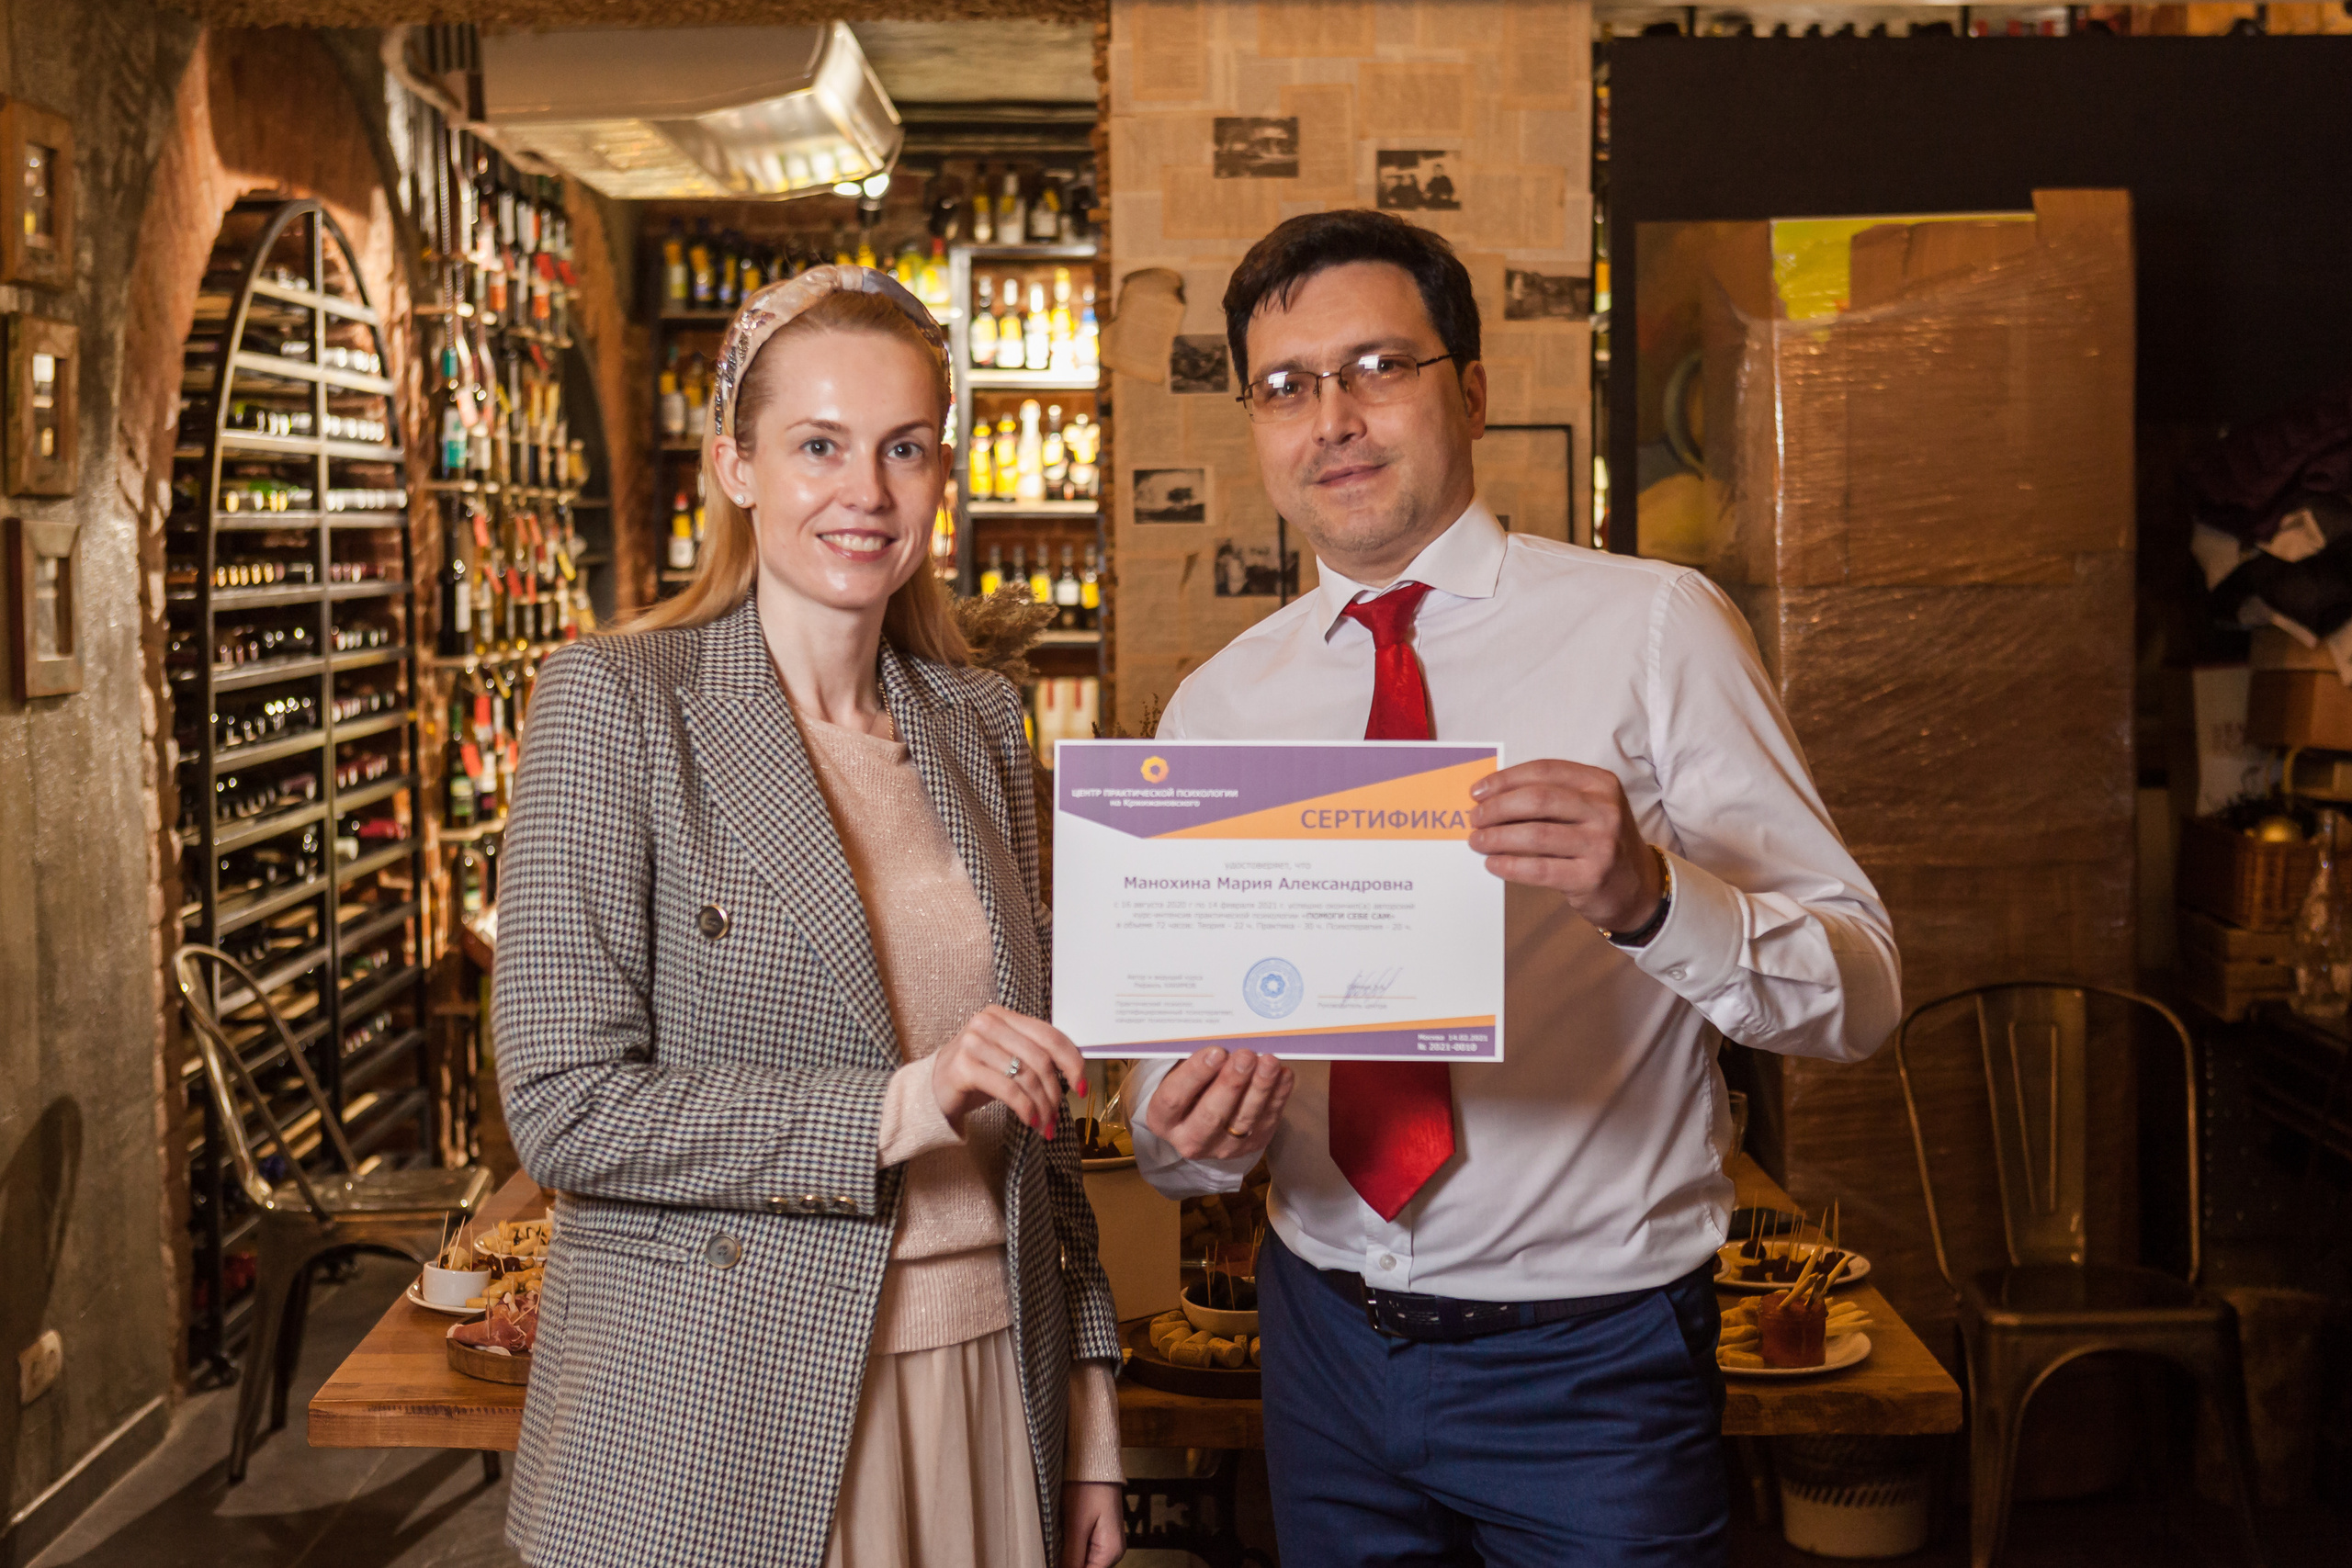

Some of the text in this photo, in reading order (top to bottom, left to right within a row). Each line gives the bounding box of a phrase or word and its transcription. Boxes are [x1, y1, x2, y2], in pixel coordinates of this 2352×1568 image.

[1071, 787, 1238, 798] ЦЕНТР ПРАКТИЧЕСКОЙ ПСИХОЛОГИИ
[1124, 876, 1414, 893] Манохина Мария Александровна
